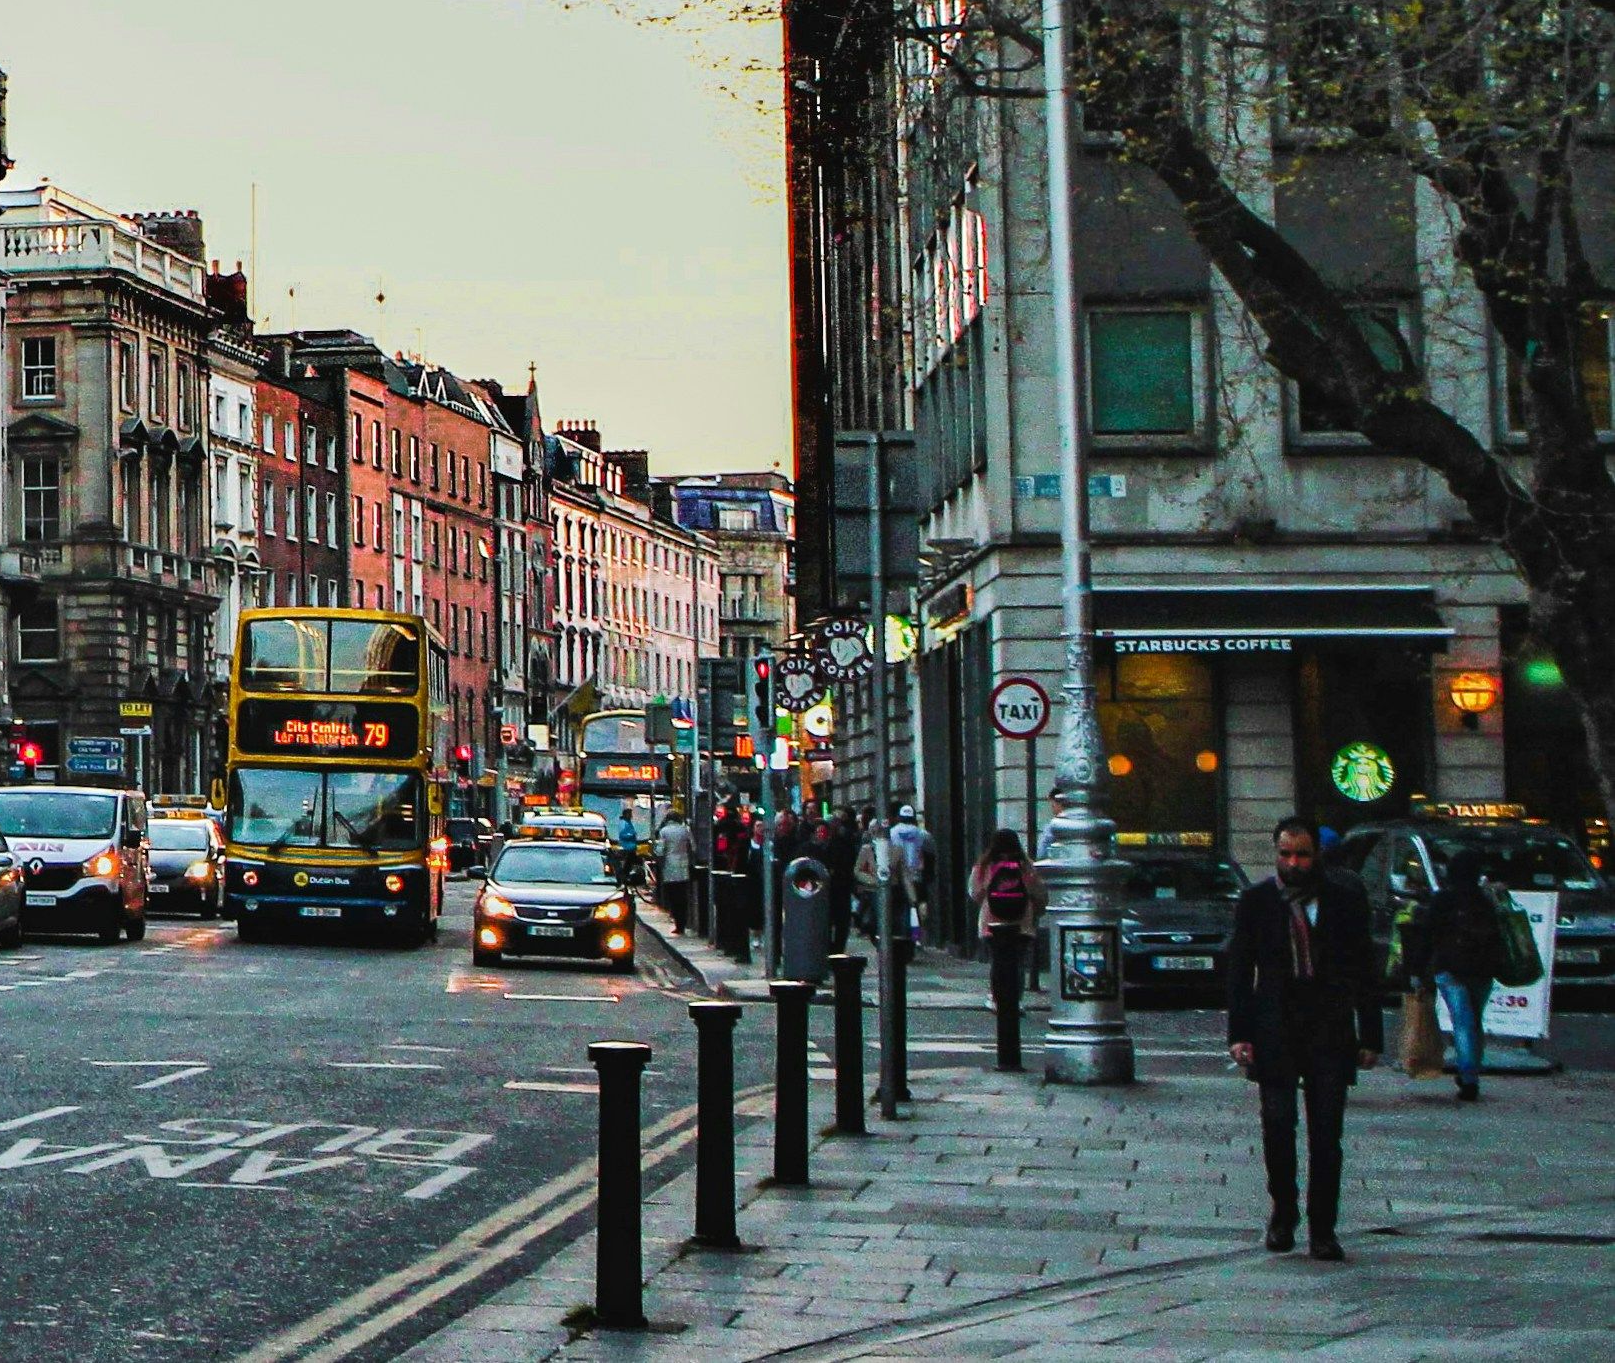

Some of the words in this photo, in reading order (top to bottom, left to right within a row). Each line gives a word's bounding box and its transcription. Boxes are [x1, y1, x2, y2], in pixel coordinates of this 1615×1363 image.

[824, 621, 867, 637] COSTA
[1115, 640, 1221, 652] STARBUCKS
[1224, 639, 1292, 651] COFFEE
[780, 660, 815, 674] COSTA
[820, 658, 873, 679] COFFEE
[776, 691, 823, 706] COFFEE
[999, 704, 1038, 719] TAXI
[286, 720, 308, 734] City
[311, 721, 348, 735] Centre
[364, 723, 387, 747] 79
